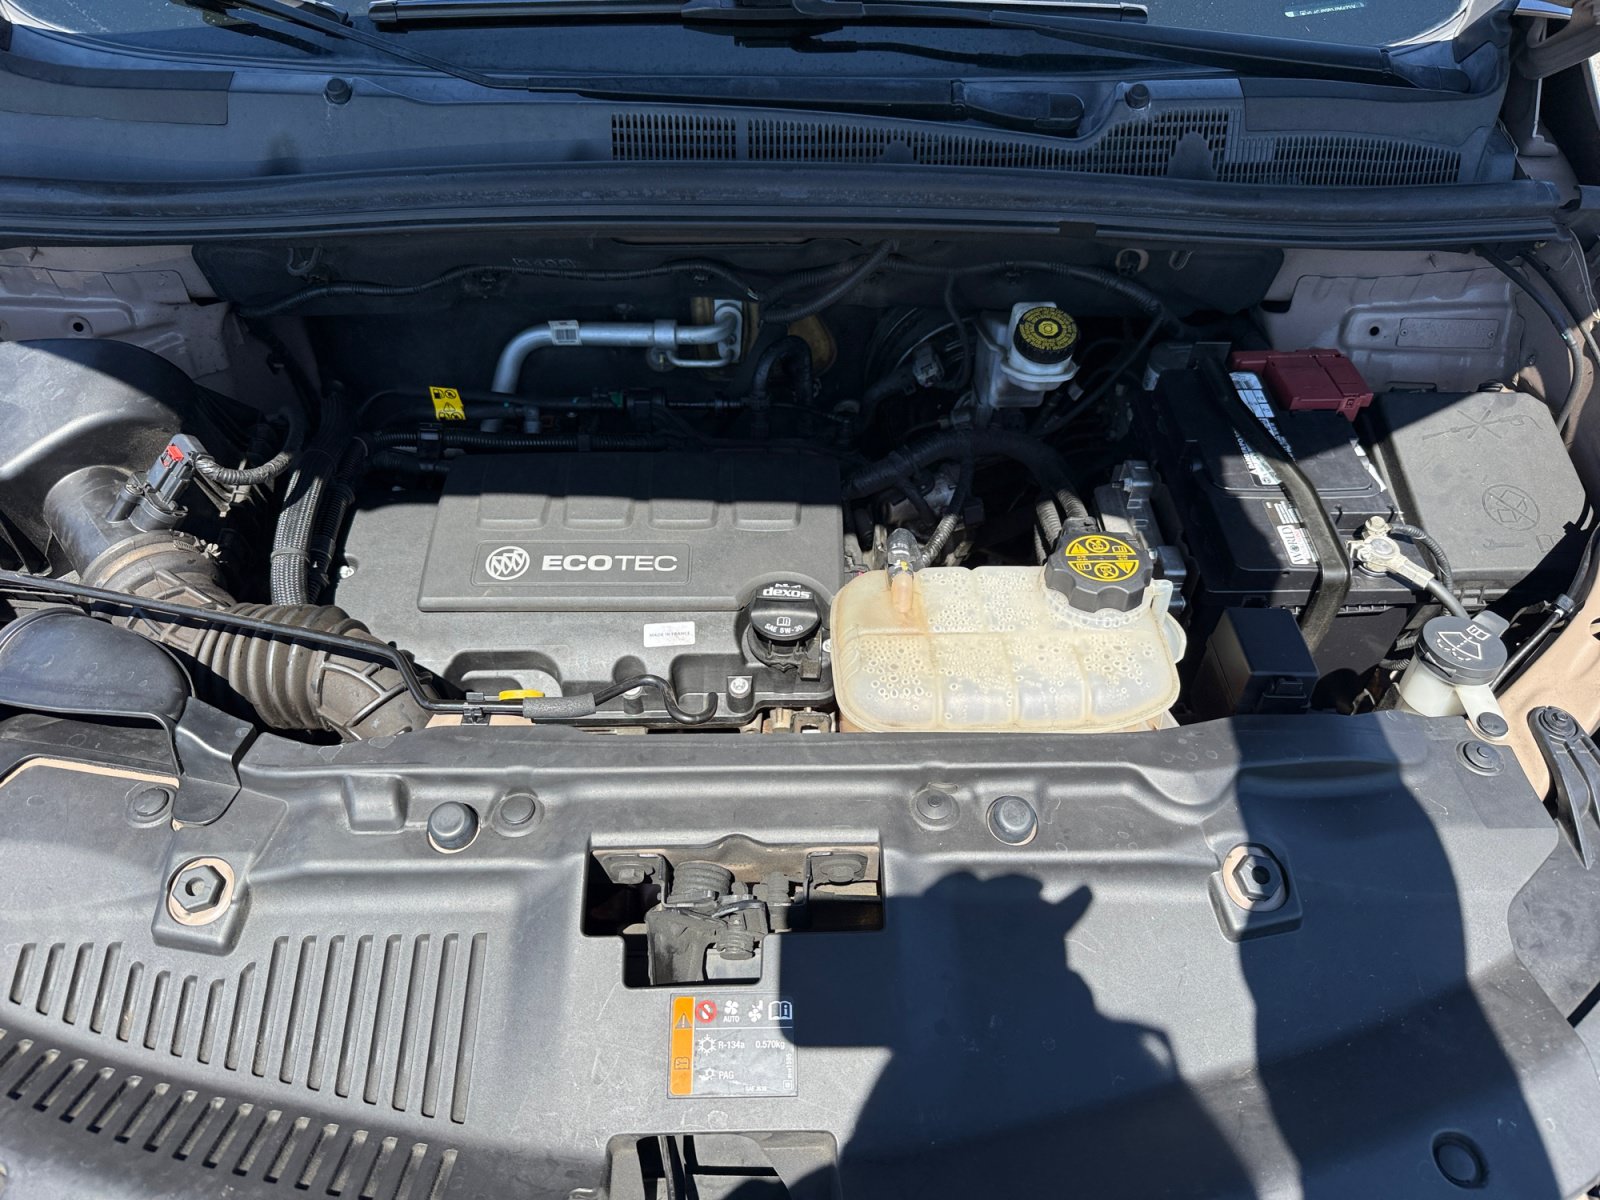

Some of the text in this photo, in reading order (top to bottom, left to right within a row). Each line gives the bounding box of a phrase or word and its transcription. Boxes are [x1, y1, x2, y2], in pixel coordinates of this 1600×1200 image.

[1282, 526, 1305, 563] WORLD
[541, 554, 678, 572] ECOTEC
[762, 586, 812, 599] dexos
[764, 623, 804, 634] SAE 5W-30
[723, 1015, 740, 1023] AUTO
[718, 1040, 786, 1050] R-134a 0.570kg
[718, 1071, 734, 1080] PAG
